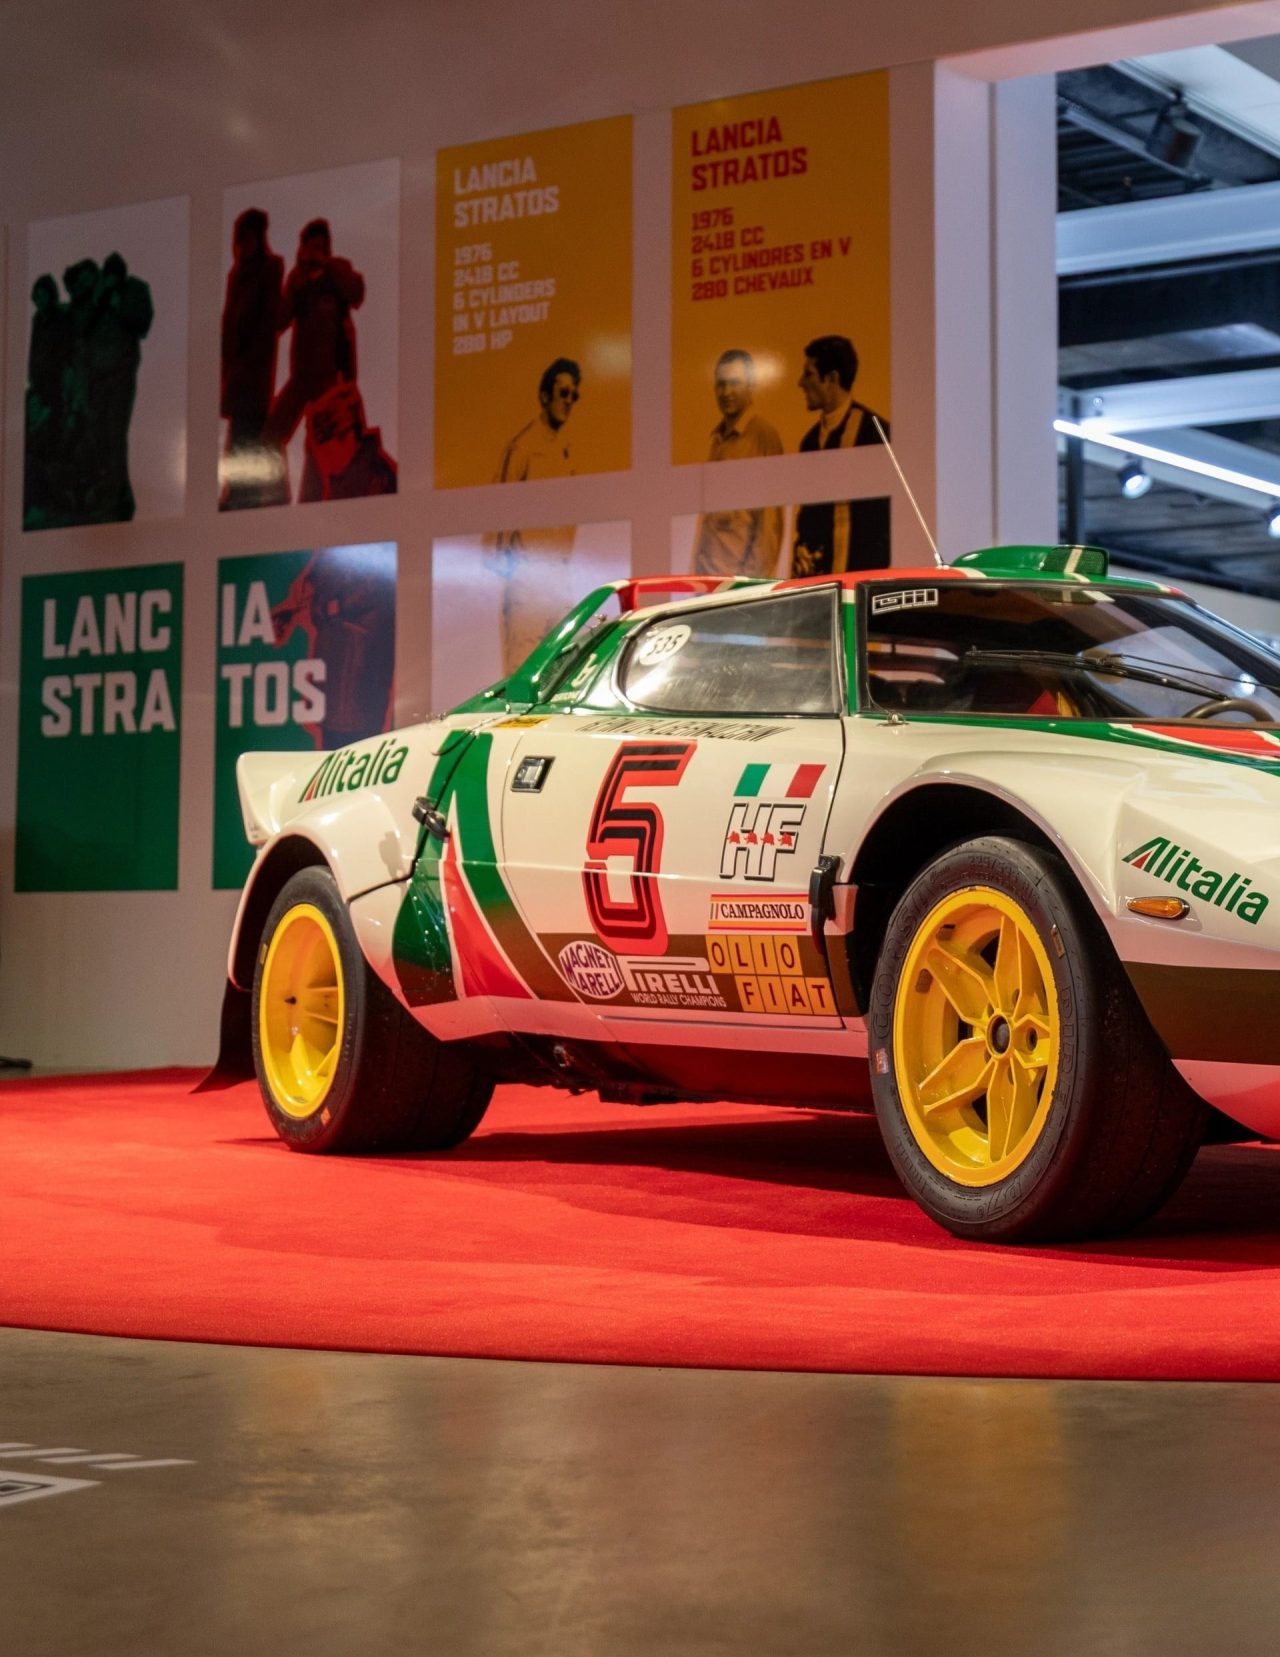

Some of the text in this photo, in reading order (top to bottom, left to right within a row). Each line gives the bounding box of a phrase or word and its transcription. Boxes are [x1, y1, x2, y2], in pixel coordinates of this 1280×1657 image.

[692, 116, 783, 157] LANCIA
[454, 156, 537, 195] LANCIA
[692, 147, 808, 191] STRATOS
[454, 185, 559, 229] STRATOS
[692, 207, 734, 231] 1976
[692, 226, 764, 254] 2418 CC
[692, 236, 852, 278] 6 CYLINDRES EN V
[497, 262, 519, 281] CC
[692, 266, 813, 301] 280 CHEVAUX
[474, 310, 485, 330] V
[491, 330, 512, 350] HP
[43, 590, 172, 659] LANC
[221, 581, 277, 647] IA
[41, 669, 177, 738] STRA
[221, 659, 327, 728] TOS
[298, 738, 409, 803] Alitalia
[719, 803, 806, 882] HF
[1121, 836, 1270, 925] Alitalia
[720, 903, 804, 919] CAMPAGNOLO
[561, 943, 619, 977] MAGNETI
[711, 942, 795, 968] OLIO
[615, 955, 720, 995] PIRELLI
[631, 992, 727, 1007] WORLD RALLY CHAMPIONS
[742, 982, 825, 1008] FIAT
